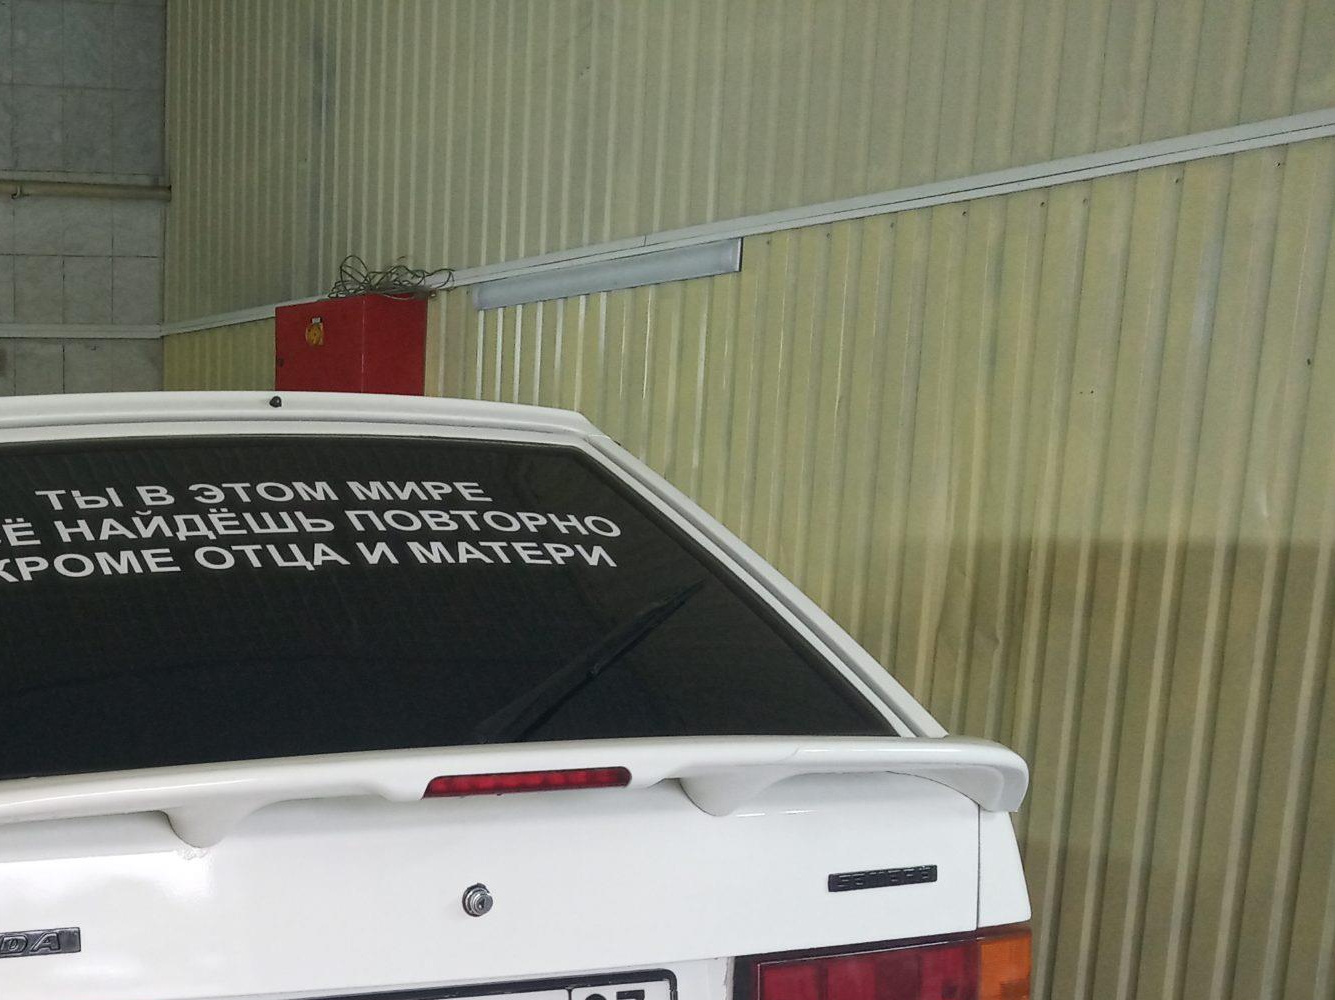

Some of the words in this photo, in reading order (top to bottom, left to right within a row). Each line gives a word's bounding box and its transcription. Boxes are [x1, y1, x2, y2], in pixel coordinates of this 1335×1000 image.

[34, 484, 124, 511] ТЫ
[135, 484, 175, 506] В
[188, 481, 339, 504] ЭТОМ
[346, 480, 493, 502] МИРЕ
[53, 507, 335, 543] НАЙДЁШЬ
[344, 509, 622, 538] ПОВТОРНО
[194, 542, 351, 571] ОТЦА
[355, 541, 399, 565] И
[406, 541, 618, 568] МАТЕРИ
